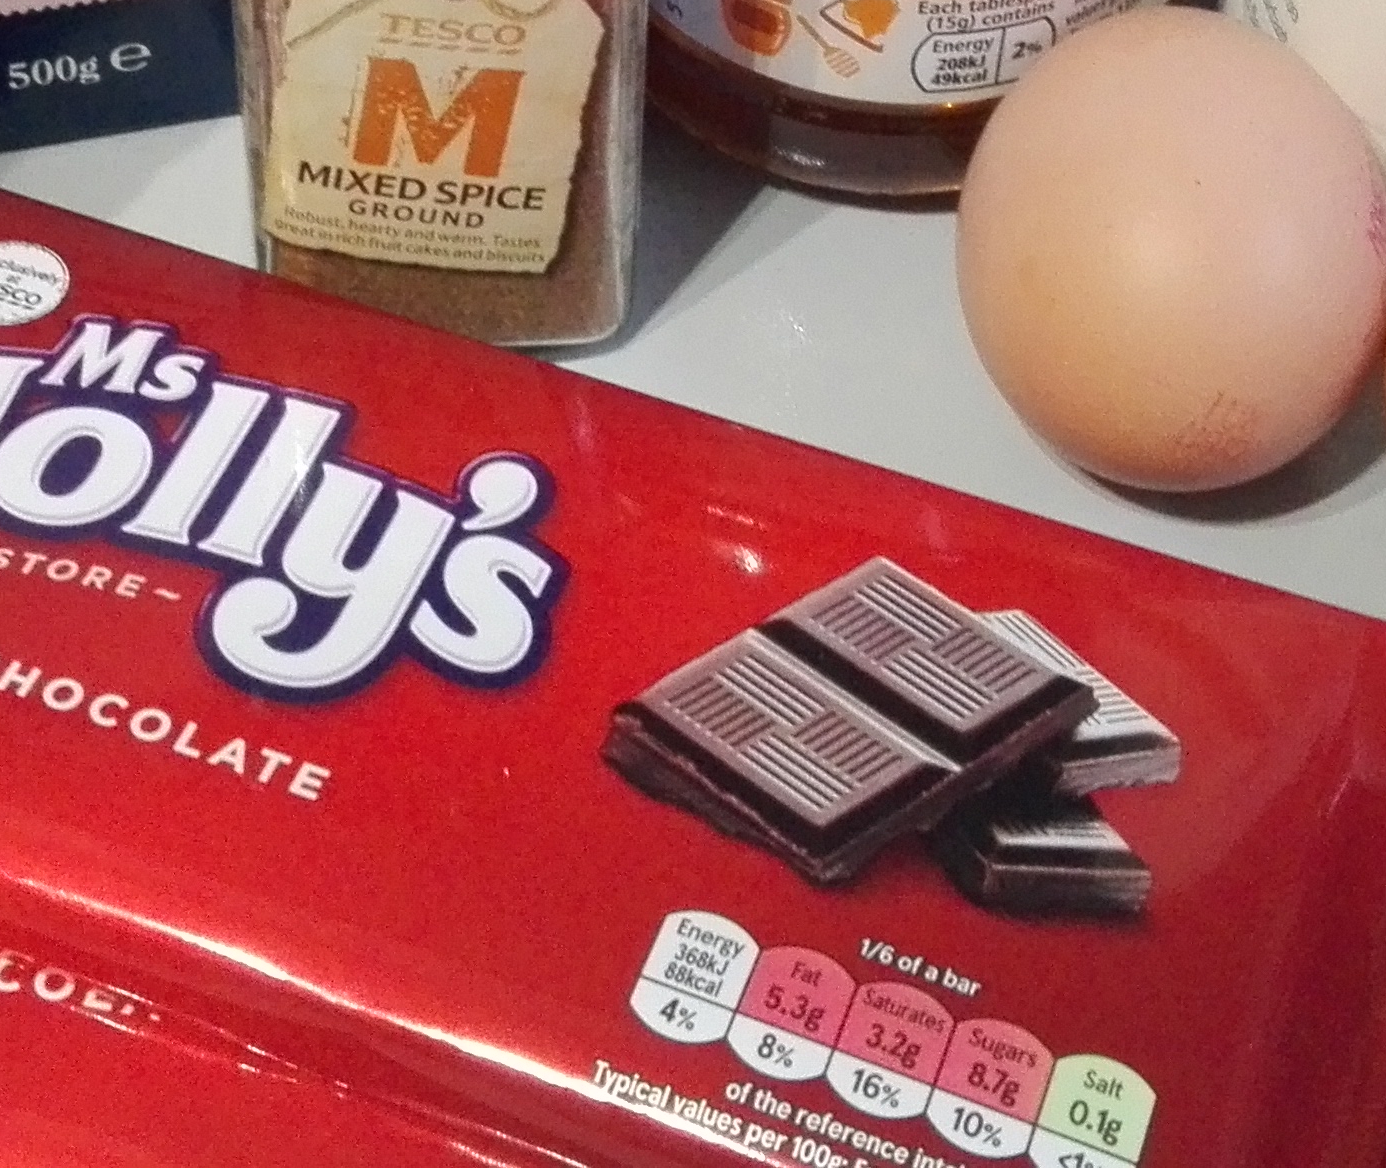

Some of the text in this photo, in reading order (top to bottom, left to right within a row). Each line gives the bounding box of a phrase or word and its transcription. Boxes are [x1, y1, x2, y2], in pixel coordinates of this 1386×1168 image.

[917, 0, 969, 16] Each
[926, 1, 1056, 33] (15g) contains
[379, 12, 527, 46] TESCO
[932, 37, 995, 56] Energy
[7, 55, 101, 91] 500g
[352, 56, 527, 179] M
[297, 160, 547, 211] MIXED SPICE
[348, 198, 485, 230] GROUND
[406, 242, 451, 258] cakes
[453, 246, 484, 261] and
[40, 320, 209, 404] Ms
[674, 942, 731, 976] 368kJ
[677, 918, 747, 959] Energy
[664, 961, 724, 998] 88kcal
[791, 960, 824, 987] Fat
[859, 937, 982, 998] 1/6 of a bar
[658, 997, 696, 1031] 4%
[764, 983, 826, 1033] 5.3g
[863, 988, 949, 1036] Saturates
[757, 1033, 794, 1068] 8%
[865, 1022, 922, 1069] 3.2g
[968, 1026, 1039, 1069] Sugars
[851, 1068, 901, 1110] 16%
[967, 1062, 1021, 1107] 8.7g
[1083, 1068, 1125, 1101] Salt
[594, 1059, 672, 1108] Typical
[673, 1093, 743, 1136] values
[744, 1124, 789, 1152] per
[726, 1081, 918, 1166] of the reference
[1069, 1099, 1123, 1147] 0.1g
[952, 1107, 1003, 1148] 10%
